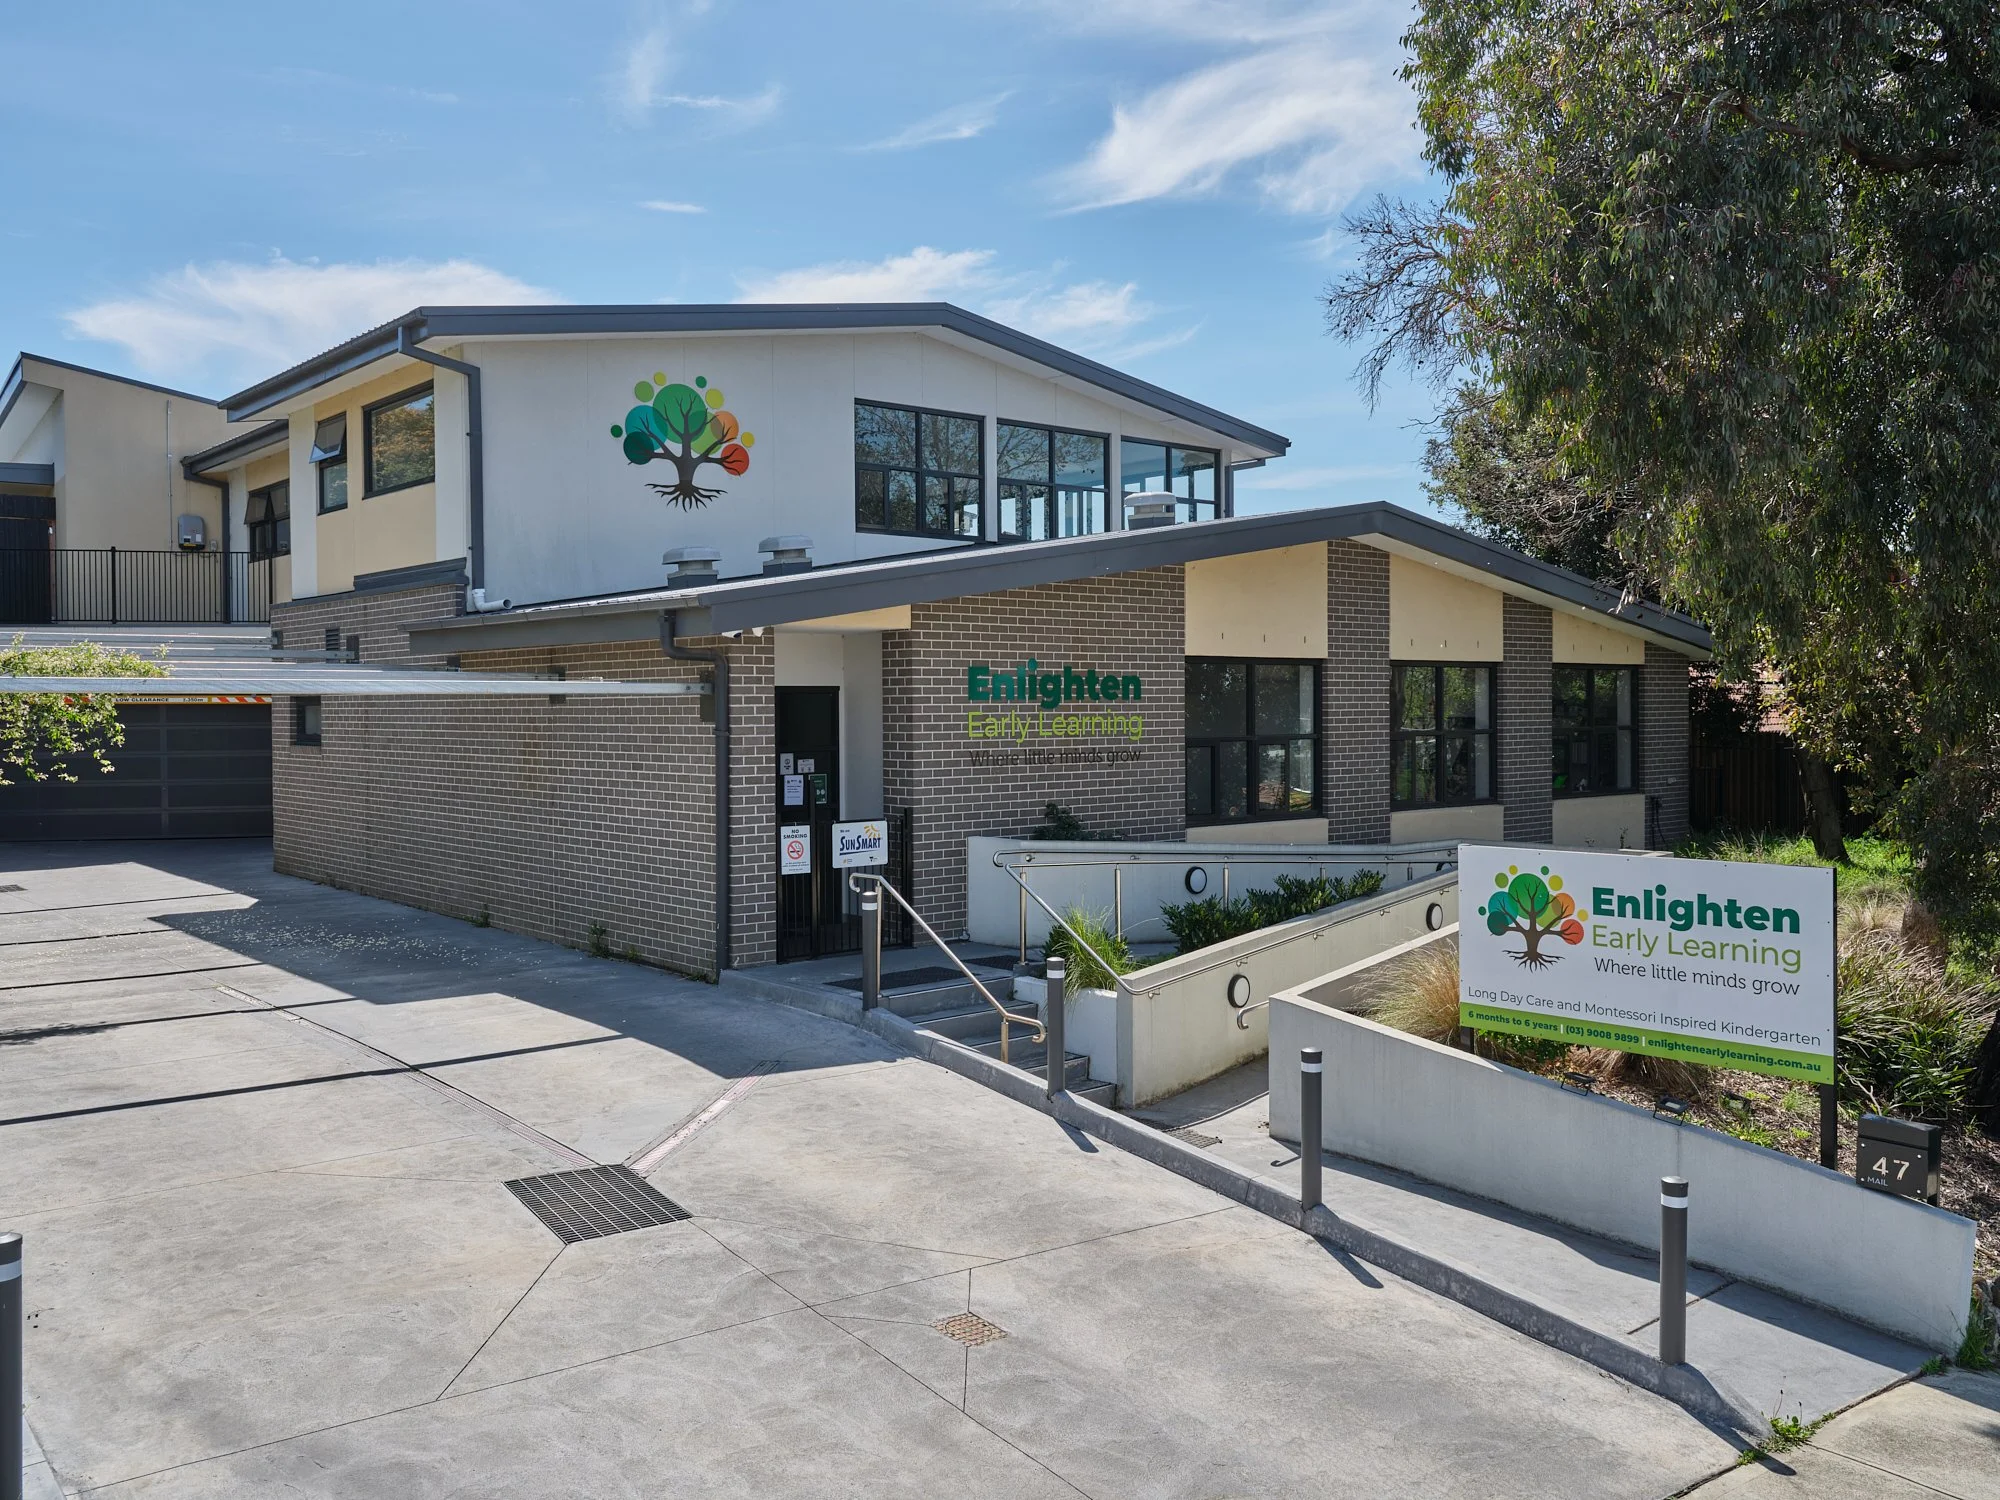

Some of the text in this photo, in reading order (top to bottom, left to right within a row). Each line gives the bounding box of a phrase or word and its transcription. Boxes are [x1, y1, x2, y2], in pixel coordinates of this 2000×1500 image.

[968, 658, 1142, 709] Enlighten
[968, 709, 1142, 744] Early Learning
[969, 748, 1142, 767] Where little minds grow
[1592, 884, 1800, 934] Enlighten
[1592, 924, 1801, 974] Early Learning
[1594, 957, 1800, 996] Where little minds grow
[1468, 986, 1821, 1046] Long Day Care and Montessori Inspired Kindergarten
[1476, 1012, 1510, 1024] months
[1512, 1018, 1522, 1026] to
[1532, 1022, 1558, 1031] years
[1566, 1024, 1584, 1036] (03)
[1587, 1028, 1612, 1040] 9008
[1614, 1032, 1639, 1044] 9899
[1648, 1038, 1821, 1072] enlightenearlylearning.com.au
[1866, 1176, 1888, 1186] MAIL
[1872, 1156, 1910, 1180] 47
